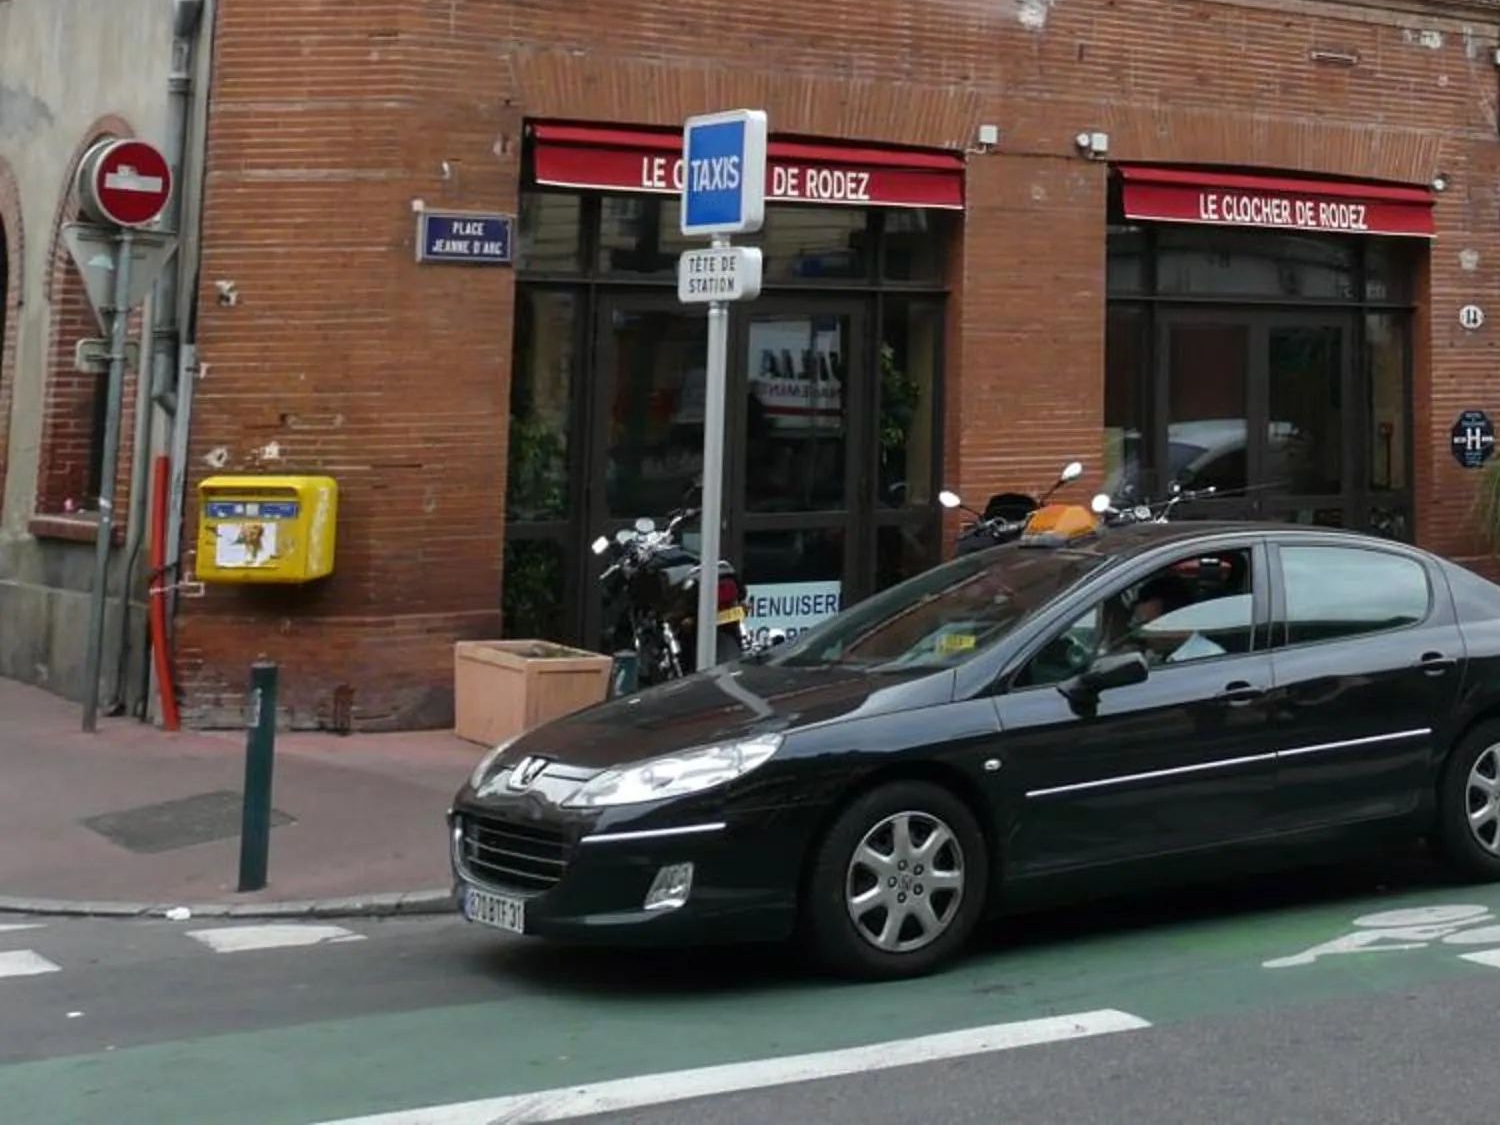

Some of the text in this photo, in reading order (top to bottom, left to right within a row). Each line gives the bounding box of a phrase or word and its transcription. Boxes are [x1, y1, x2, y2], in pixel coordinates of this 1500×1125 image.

[642, 157, 666, 188] LE
[773, 166, 800, 197] DE
[805, 169, 870, 200] RODEZ
[690, 155, 740, 192] TAXIS
[1200, 194, 1367, 230] LE CLOCHER DE RODEZ
[452, 221, 485, 236] PLACE
[432, 239, 503, 254] JEANNE D'ARC
[721, 255, 736, 272] DE
[688, 278, 735, 294] STATION
[1466, 427, 1481, 450] H
